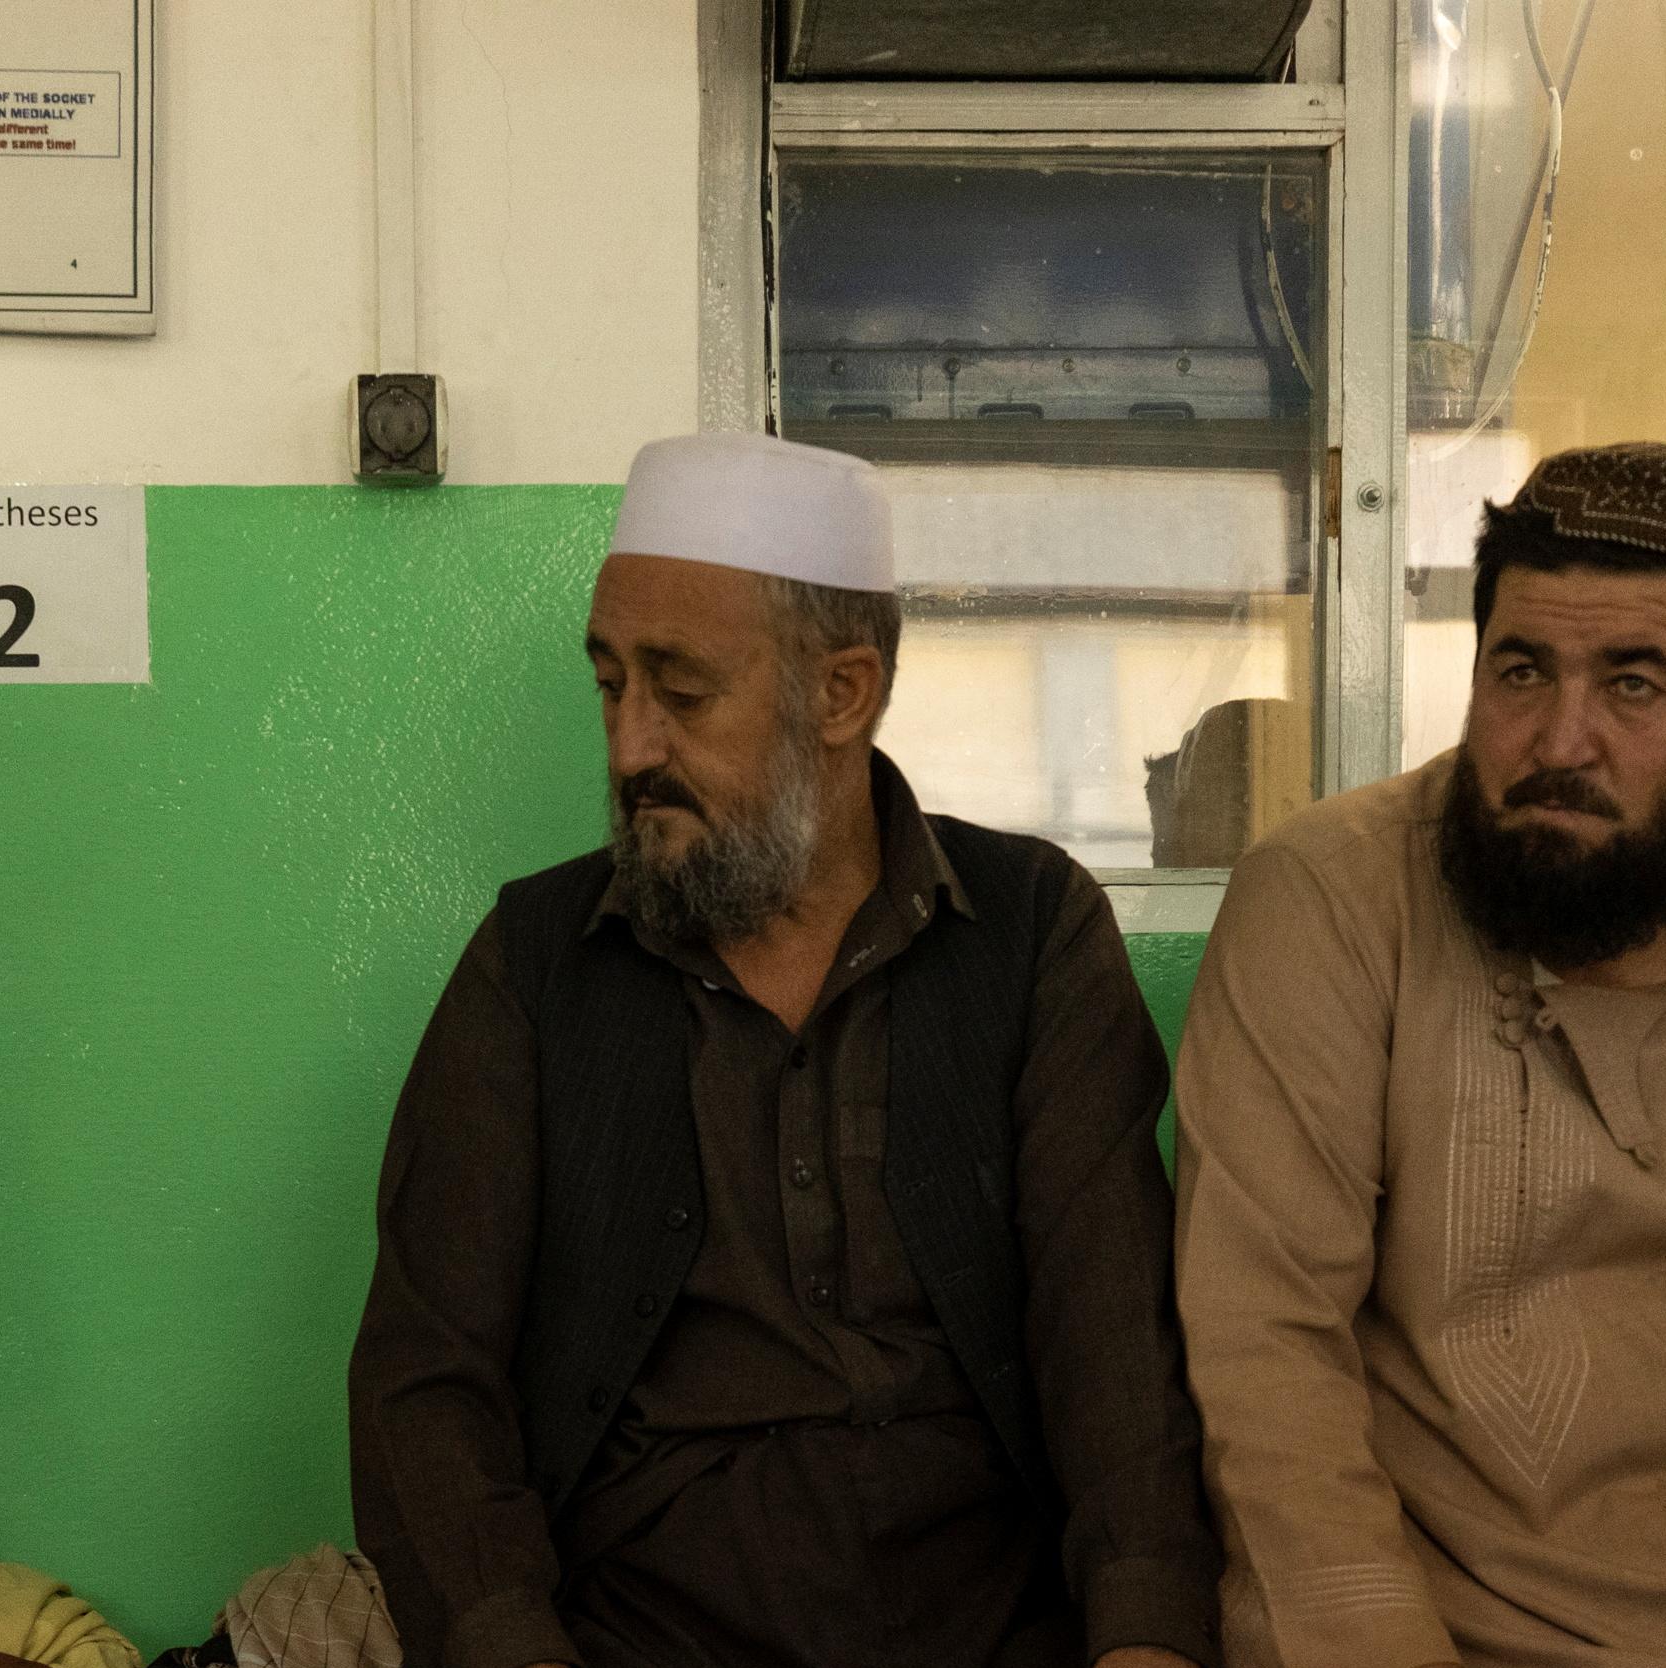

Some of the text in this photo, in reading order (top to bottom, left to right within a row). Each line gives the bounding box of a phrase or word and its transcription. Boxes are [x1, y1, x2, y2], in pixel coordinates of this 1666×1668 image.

[13, 93, 38, 103] THE
[43, 93, 95, 104] SOCKET
[11, 109, 75, 119] MEDIALLY
[12, 140, 43, 149] same
[46, 139, 76, 150] time!
[70, 258, 77, 269] 4
